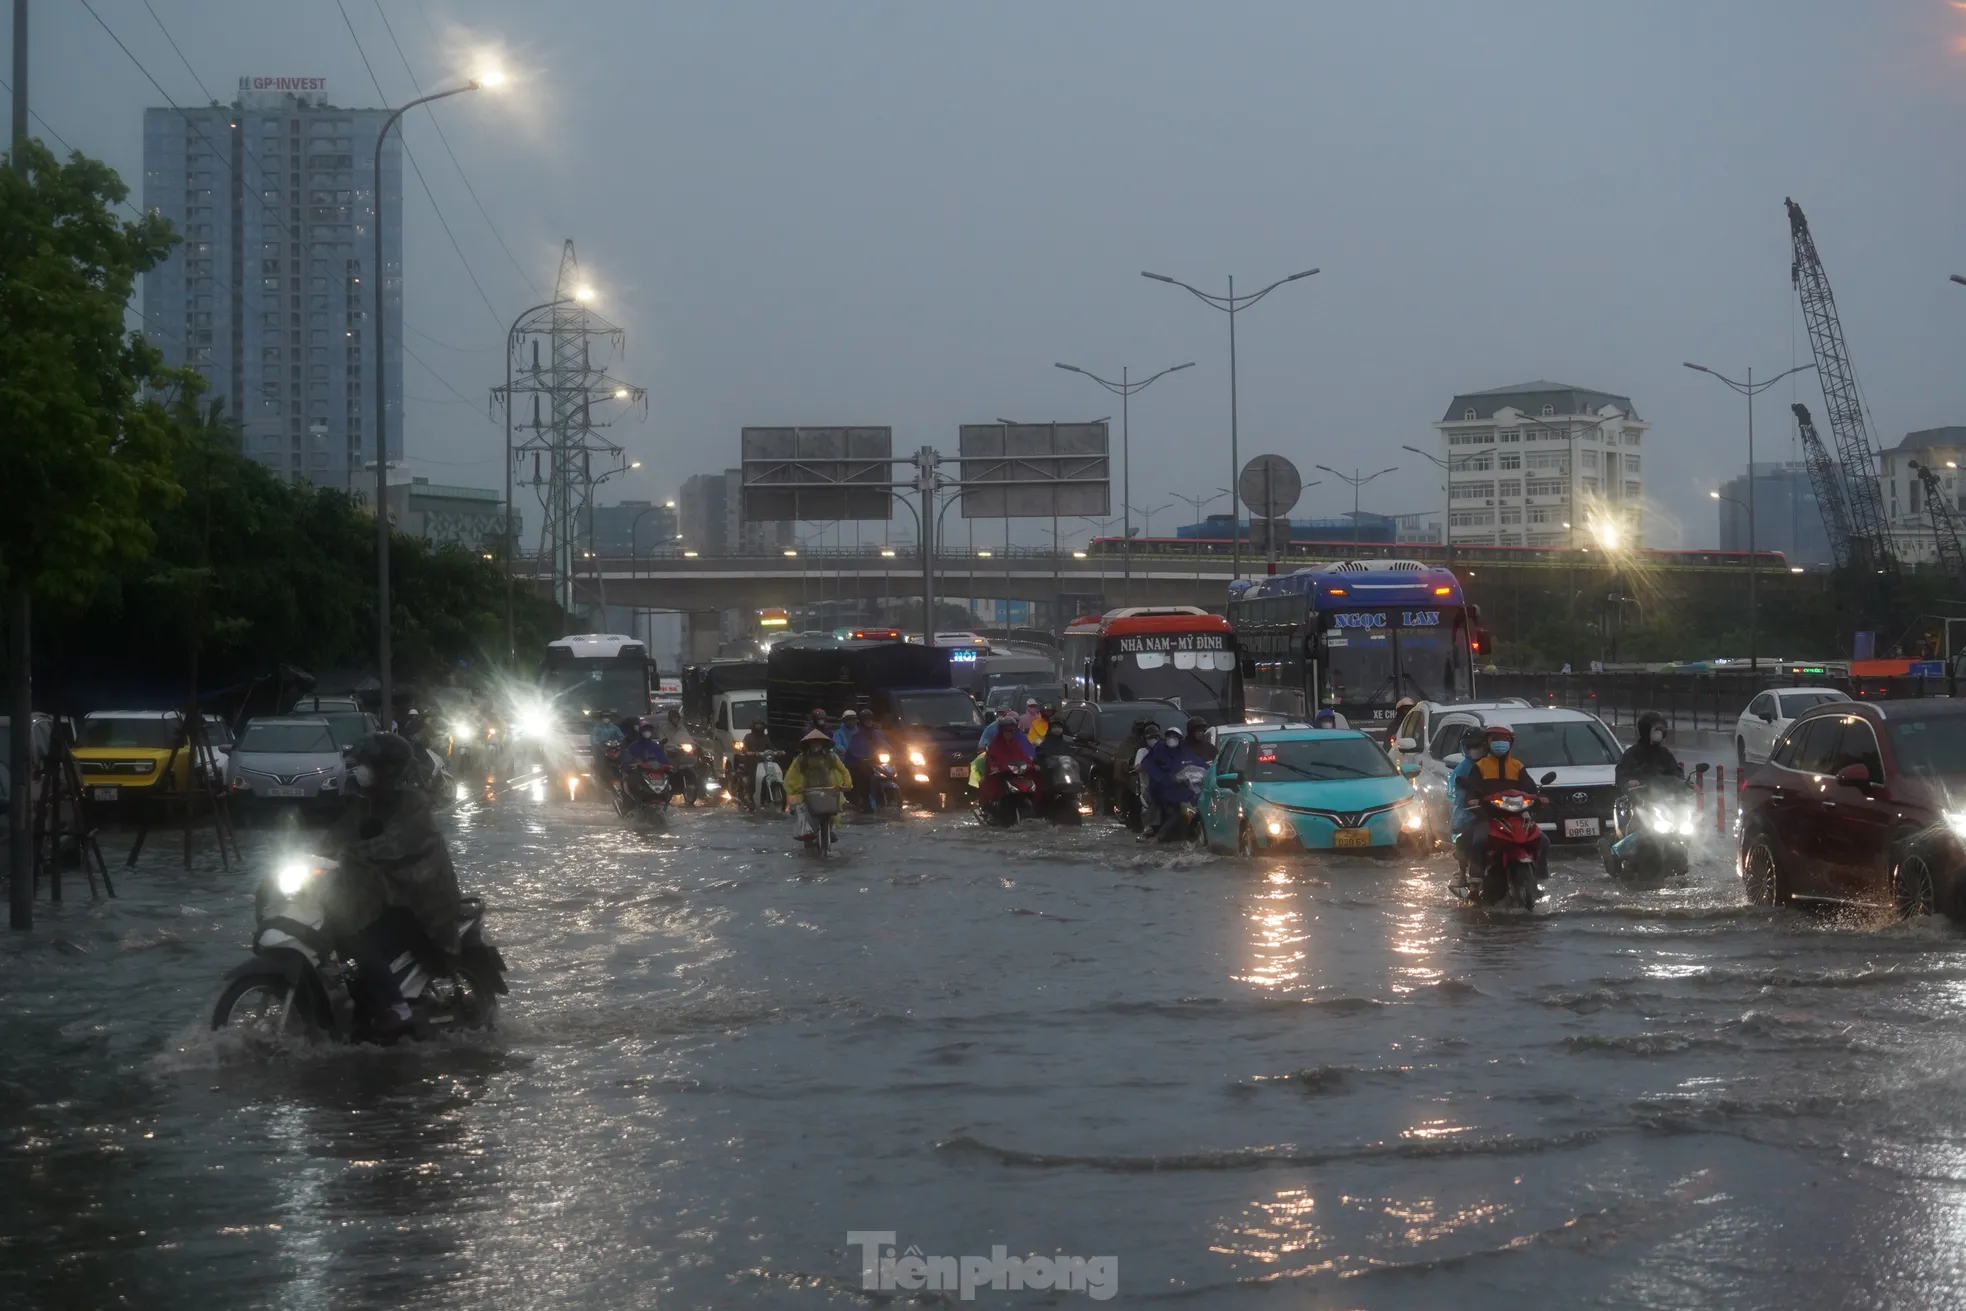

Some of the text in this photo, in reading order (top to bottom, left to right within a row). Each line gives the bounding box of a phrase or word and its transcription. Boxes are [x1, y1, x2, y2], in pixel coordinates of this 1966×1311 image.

[1334, 611, 1440, 631] NGỌC LAN
[1120, 635, 1144, 652] NHÃ
[1196, 633, 1223, 649] ĐÌNH
[1373, 710, 1397, 719] XE CH
